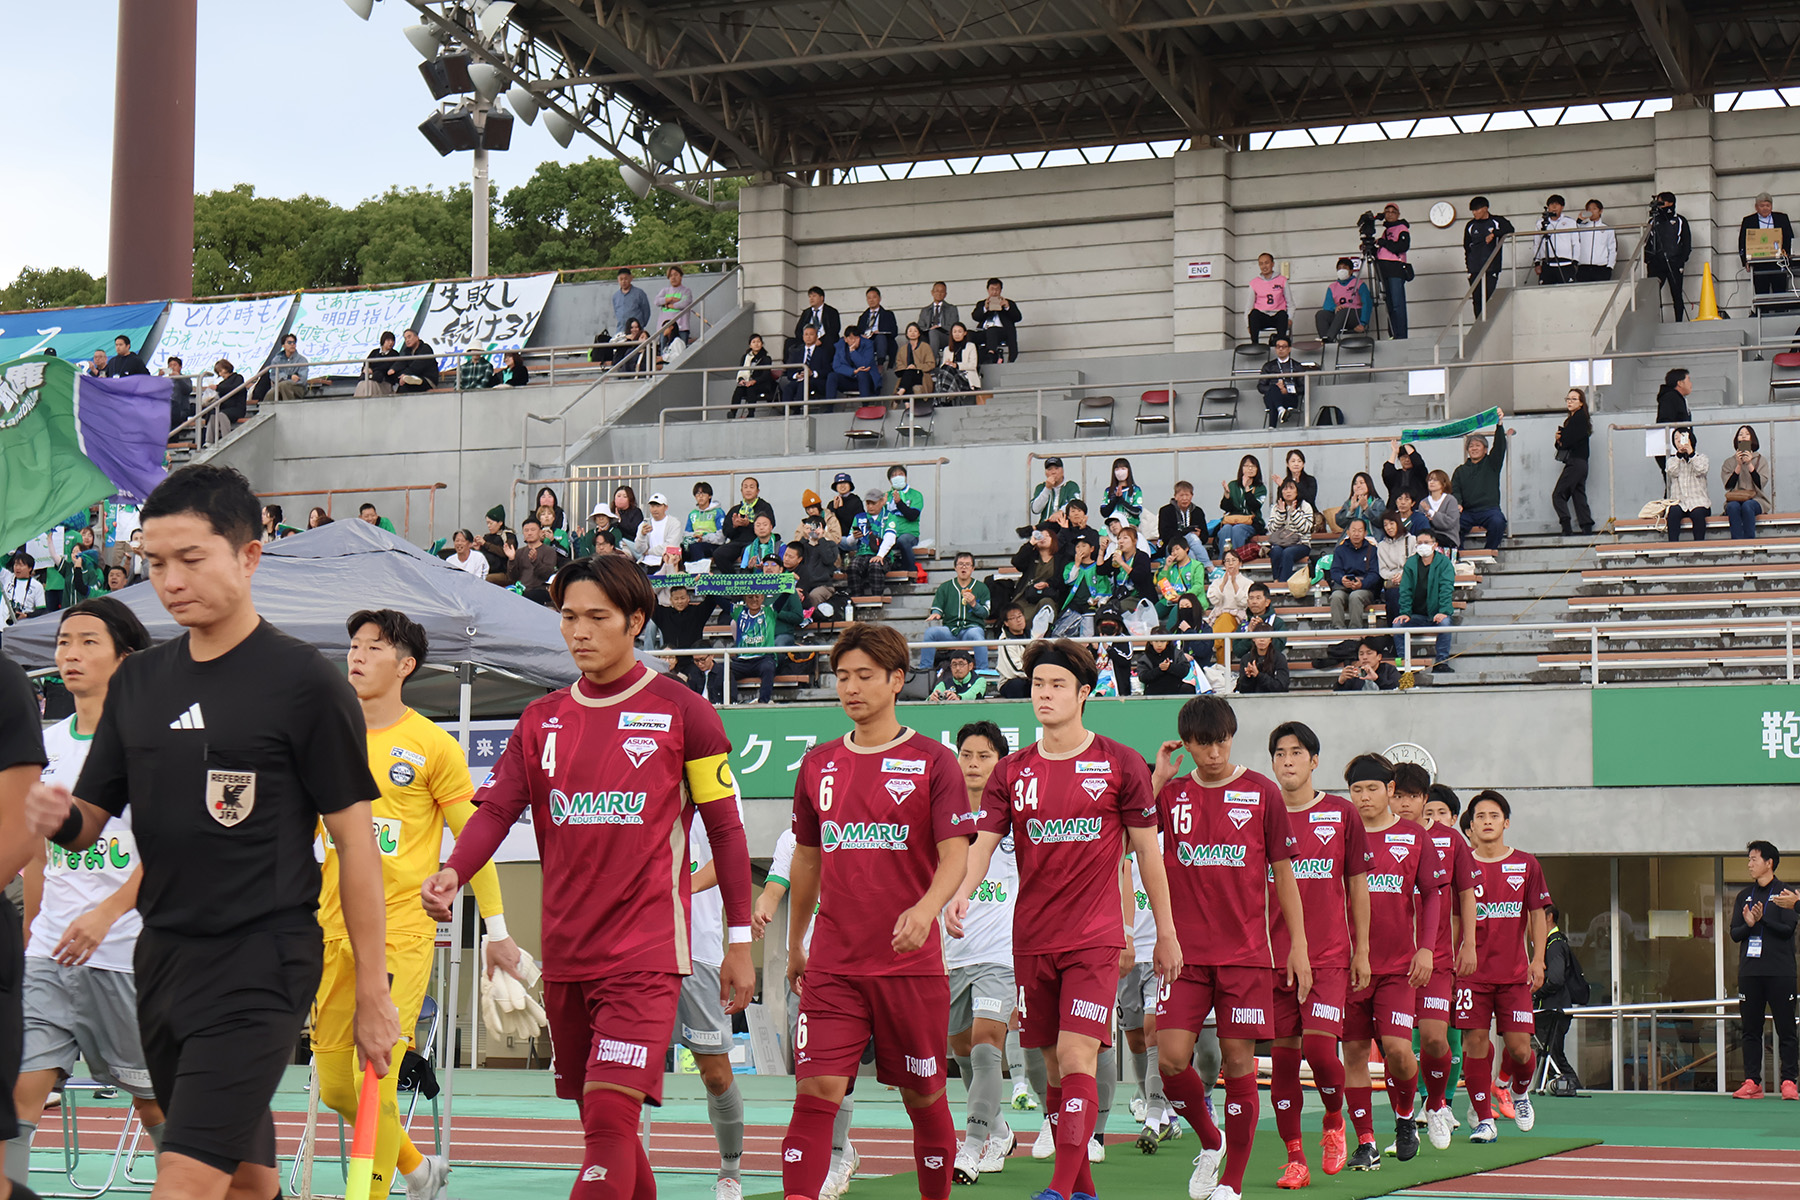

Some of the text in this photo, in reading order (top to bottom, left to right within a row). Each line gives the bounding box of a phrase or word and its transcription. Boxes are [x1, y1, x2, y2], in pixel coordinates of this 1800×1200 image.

[1191, 266, 1209, 275] ENG
[430, 280, 520, 316] 失敗し
[734, 579, 754, 587] para
[541, 732, 557, 777] 4
[211, 773, 252, 784] REFEREE
[569, 791, 647, 815] MARU
[819, 775, 835, 812] 6
[1014, 777, 1038, 812] 34
[218, 811, 239, 820] JFA
[1043, 816, 1102, 836] MARU
[1171, 804, 1192, 834] 15
[842, 823, 909, 843] MARU
[1193, 844, 1247, 860] MARU
[1487, 902, 1523, 913] MARU
[1456, 988, 1473, 1010] 23
[1071, 998, 1109, 1025] TSURUTA
[1231, 1007, 1266, 1025] TSURUTA
[1311, 1002, 1341, 1023] TSURUTA
[796, 1013, 808, 1050] 6
[597, 1039, 648, 1069] TSURUTA
[904, 1055, 938, 1078] TSURUTA
